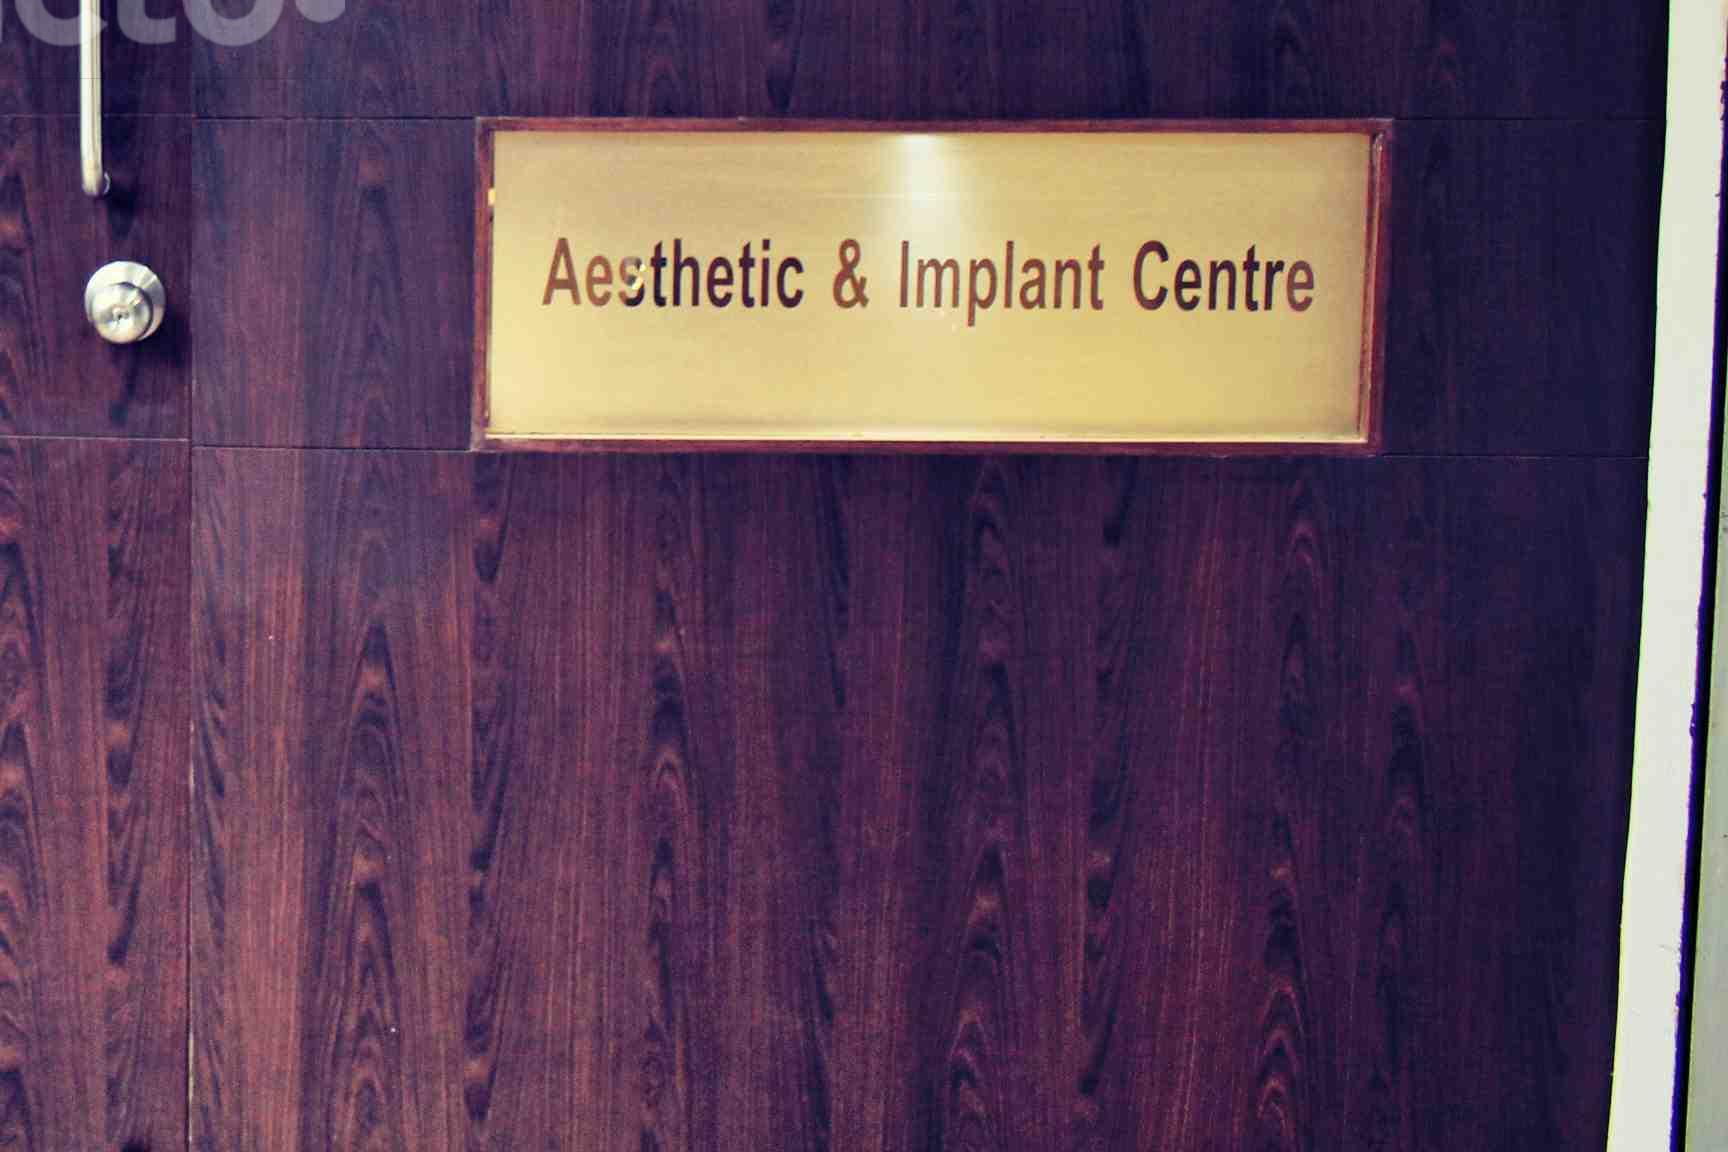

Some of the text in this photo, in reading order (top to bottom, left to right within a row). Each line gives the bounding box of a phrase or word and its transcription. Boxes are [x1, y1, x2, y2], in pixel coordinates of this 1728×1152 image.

[542, 237, 1316, 326] Aesthetic & Implant Centre
